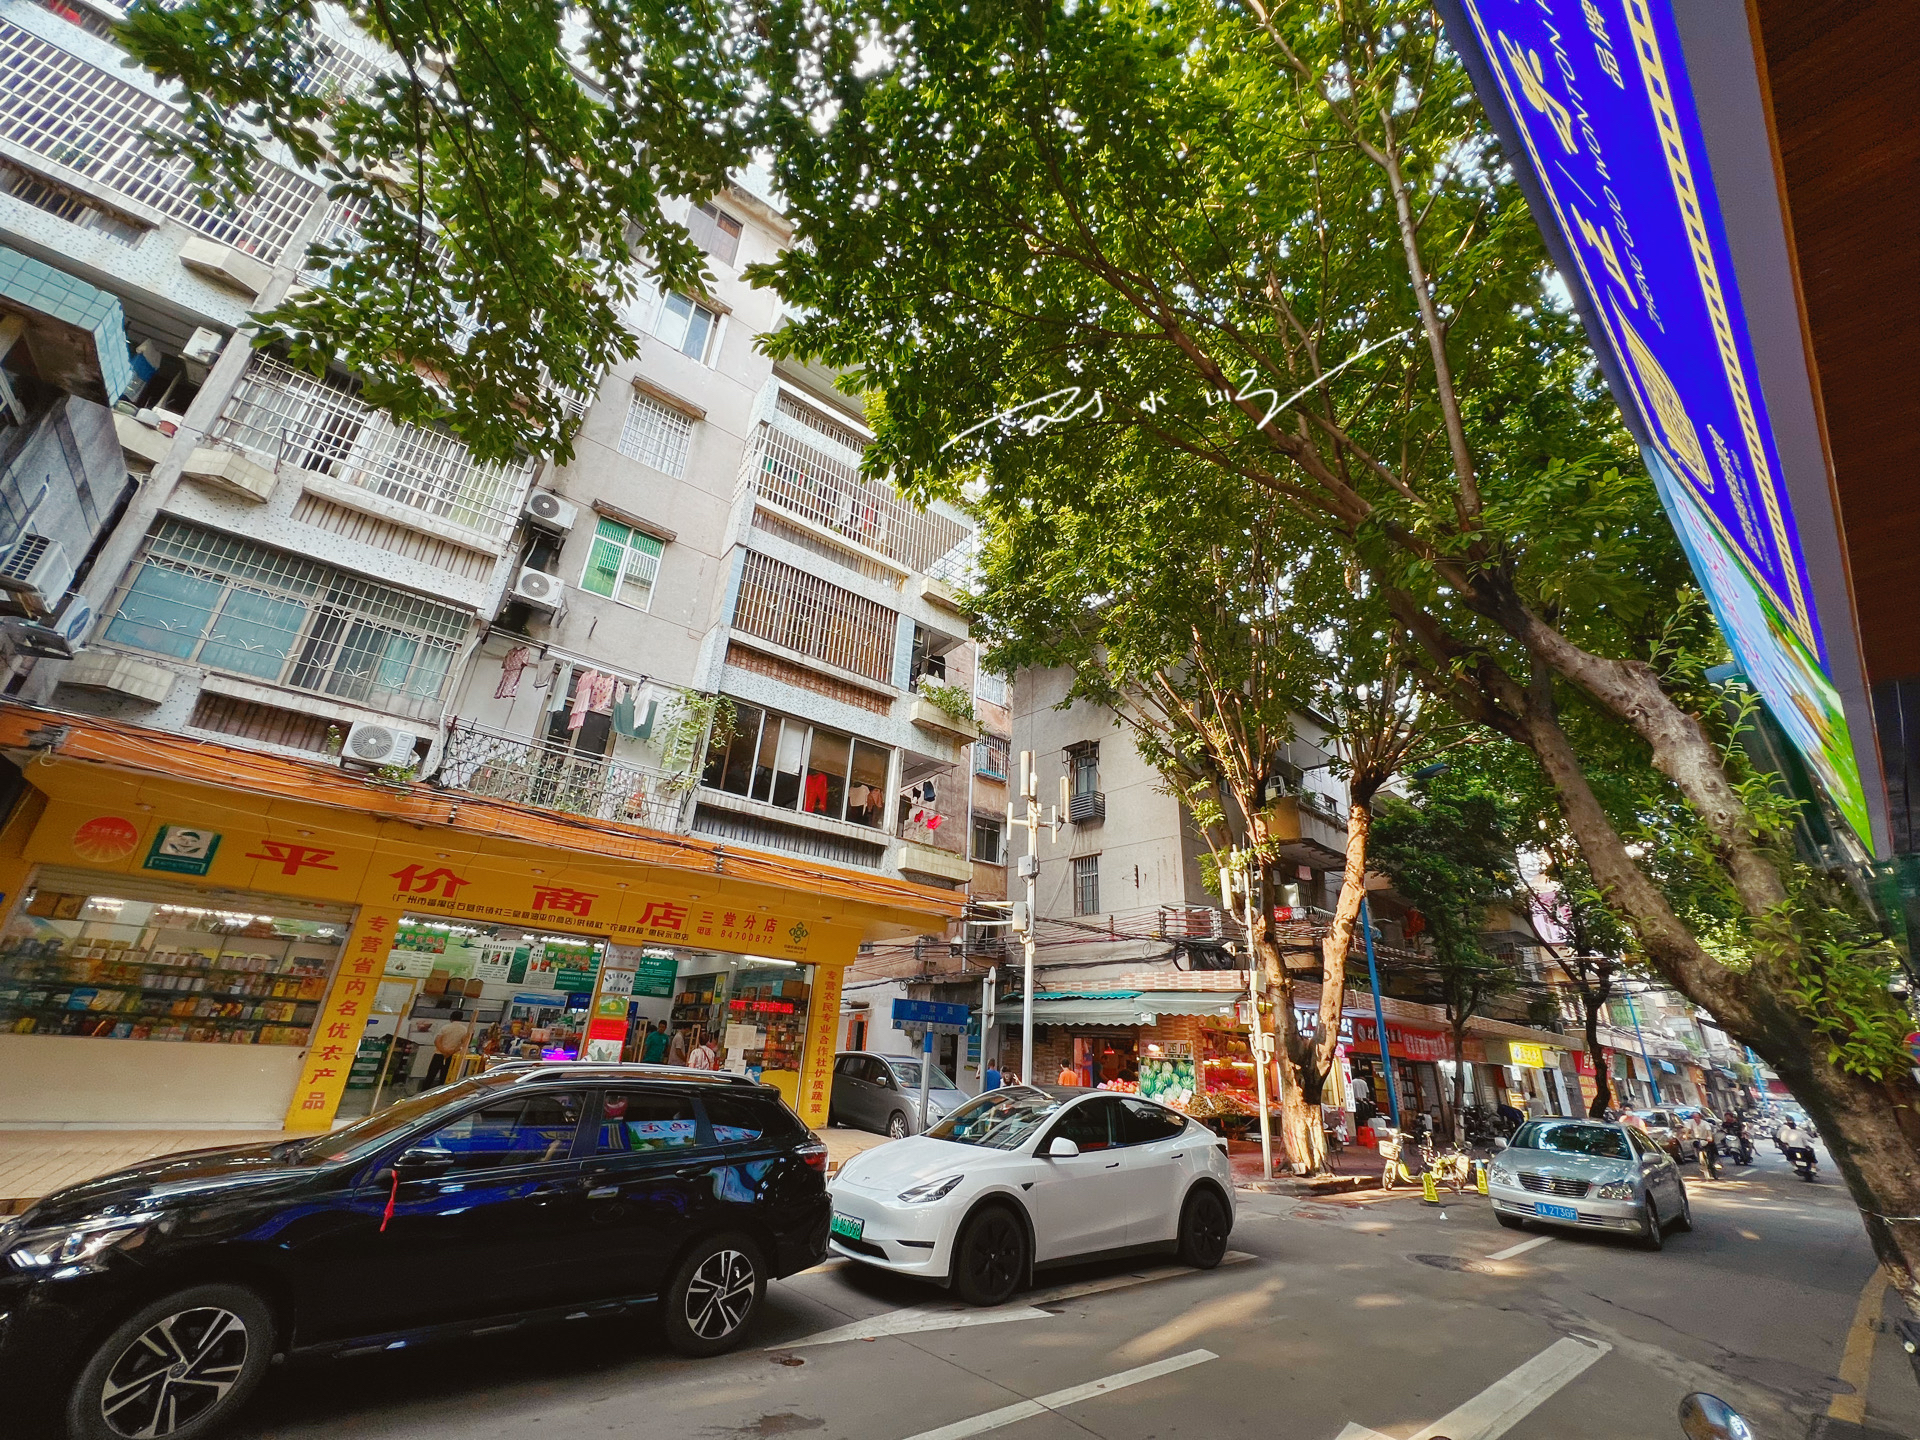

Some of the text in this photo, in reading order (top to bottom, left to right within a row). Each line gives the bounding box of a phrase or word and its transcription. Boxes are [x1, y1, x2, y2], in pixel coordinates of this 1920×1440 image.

[1543, 20, 1611, 181] WONTON
[1603, 184, 1634, 248] GUO
[1625, 246, 1665, 334] ZHENG
[245, 839, 689, 930] 平价商店
[699, 911, 778, 933] 三堂分店
[720, 929, 774, 945] 84700872
[301, 915, 390, 1111] 专营省内名优农产品
